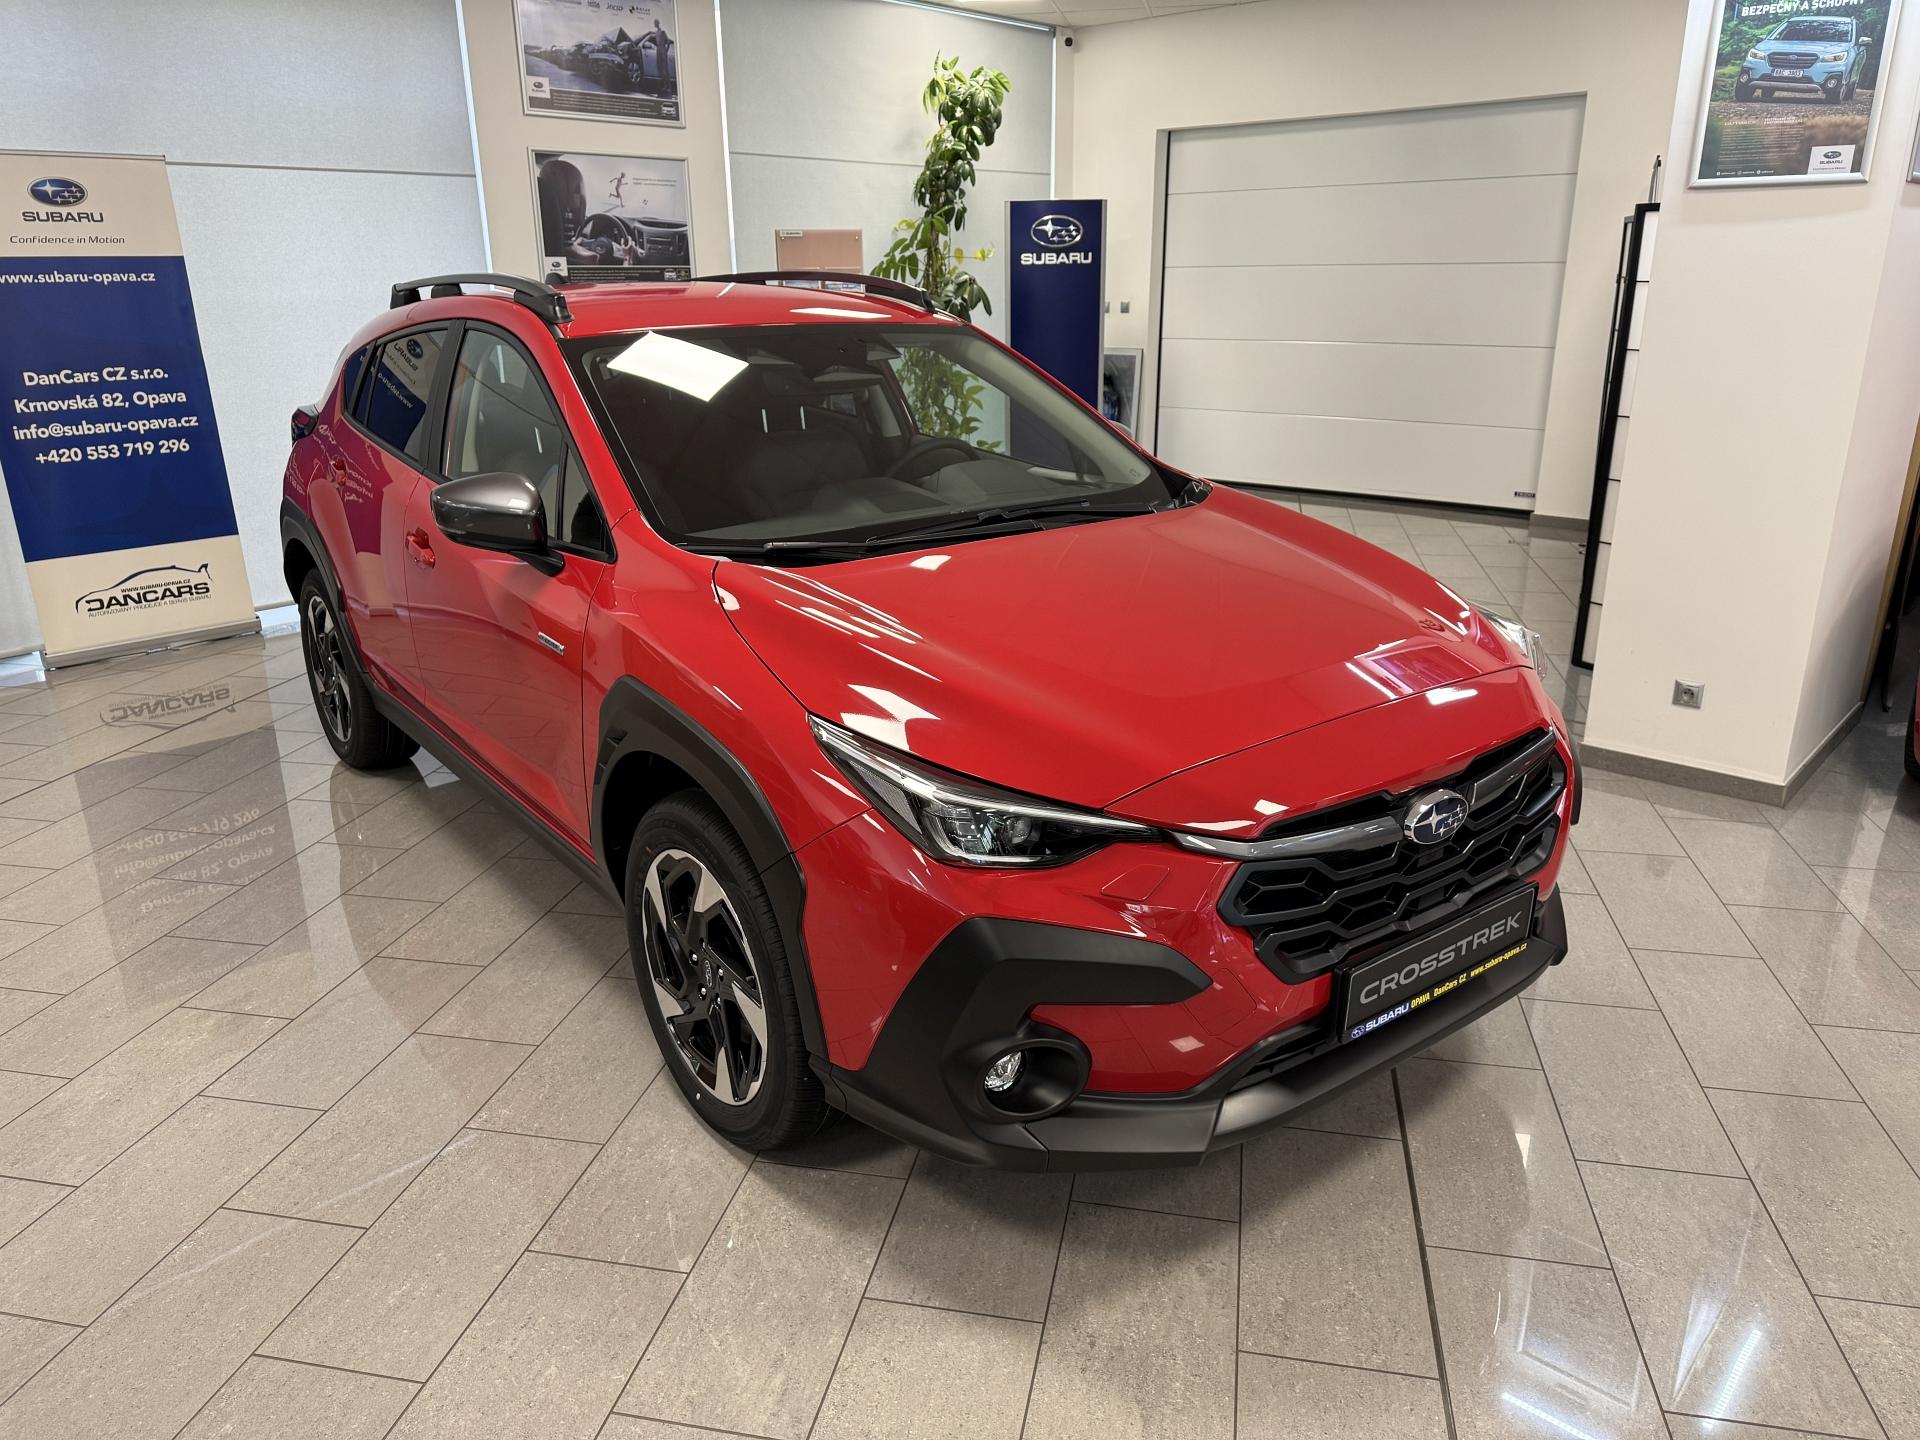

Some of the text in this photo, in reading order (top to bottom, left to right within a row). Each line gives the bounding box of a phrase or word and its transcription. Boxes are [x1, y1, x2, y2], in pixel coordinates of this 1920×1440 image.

[22, 211, 104, 223] SUBARU
[9, 235, 126, 244] Confidence in Motion
[1020, 252, 1093, 265] SUBARU
[23, 367, 169, 386] DanCars CZ s.r.o.
[14, 390, 187, 414] Krnovská 82, Opava
[12, 415, 199, 441] info@subaru-opava.cz
[35, 438, 190, 464] +420 553 719 296
[85, 582, 210, 612] DANCARS
[1359, 910, 1523, 1005] CROSSTREK
[1365, 1002, 1410, 1032] SUBARU
[1410, 991, 1431, 1010] OPAVA
[1433, 979, 1458, 998] DanCars
[1458, 972, 1467, 983] CZ
